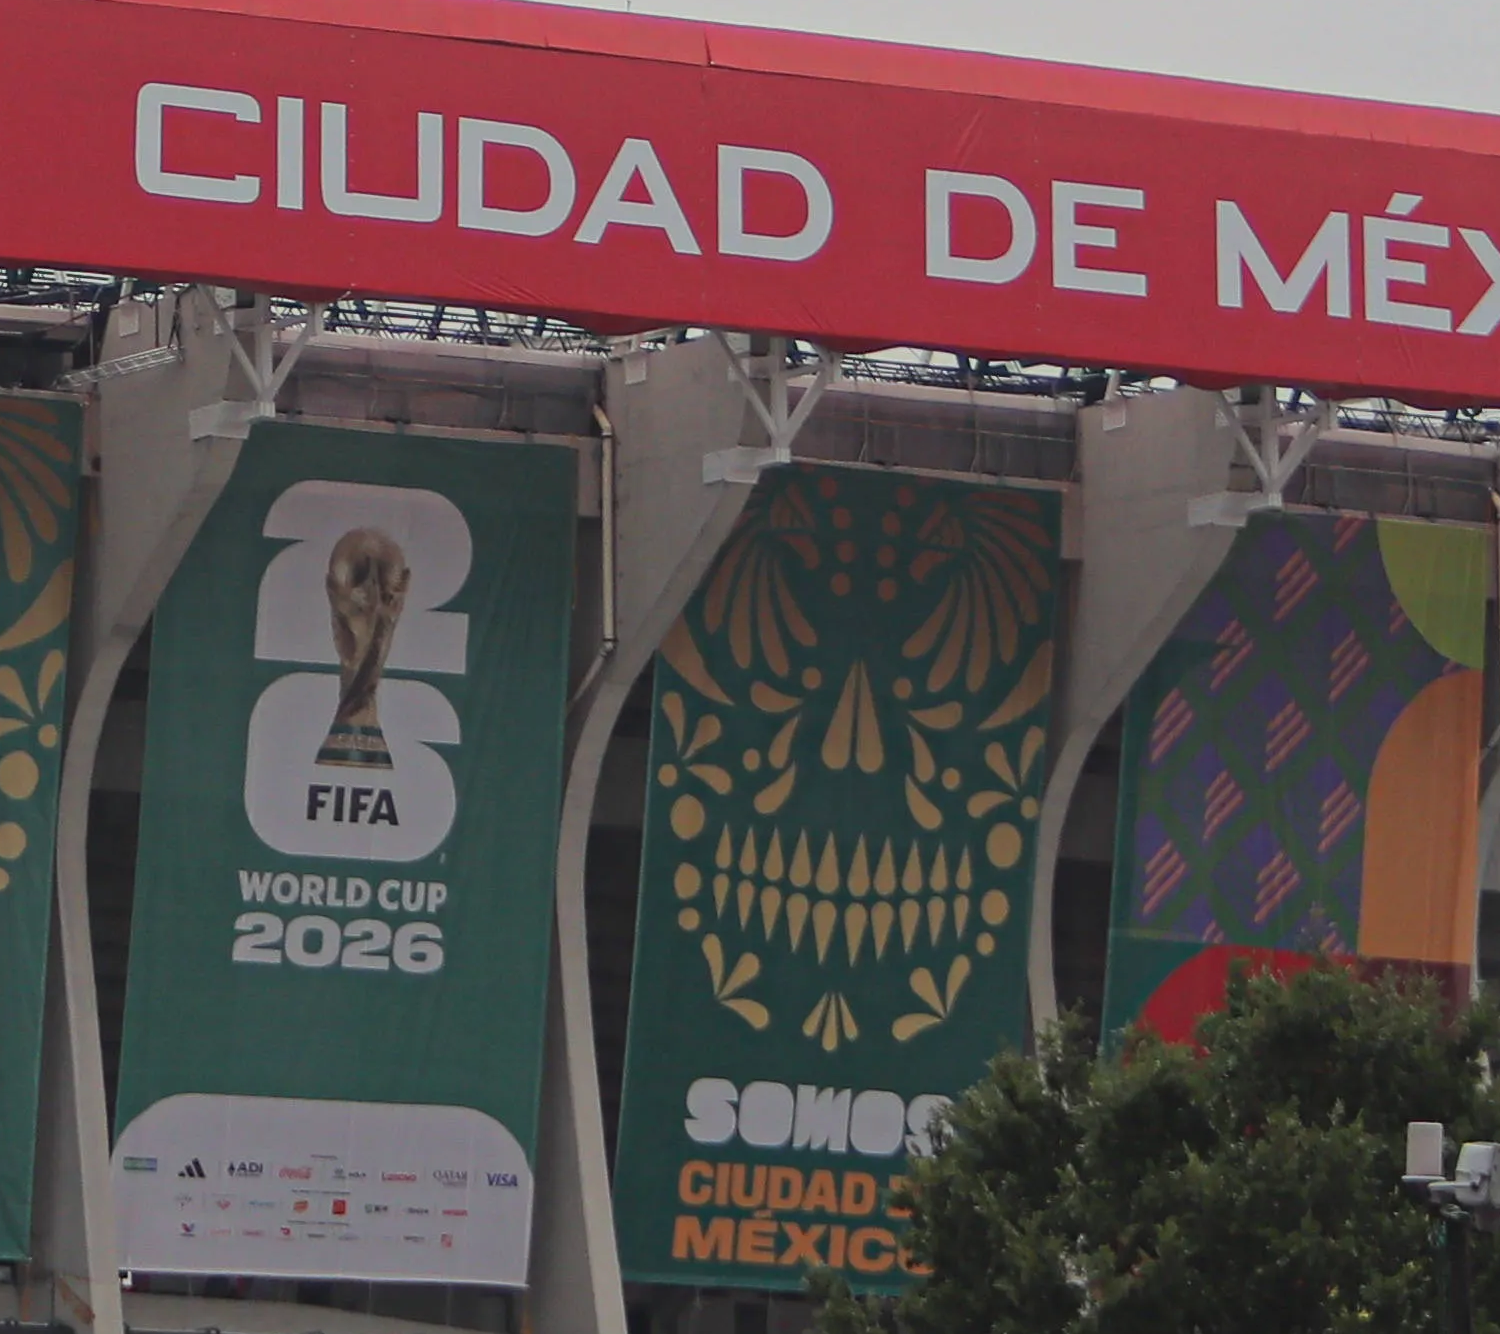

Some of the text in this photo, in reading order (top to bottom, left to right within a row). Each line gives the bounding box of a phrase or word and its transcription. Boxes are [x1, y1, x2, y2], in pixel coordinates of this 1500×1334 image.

[134, 80, 834, 263] CIUDAD
[925, 169, 1148, 299] DE
[306, 783, 400, 826] FIFA
[238, 869, 447, 914] WORLD CUP
[231, 911, 445, 975] 2026
[684, 1076, 957, 1158] SOMOS
[486, 1173, 519, 1187] VISA
[678, 1159, 876, 1216] CIUDAD
